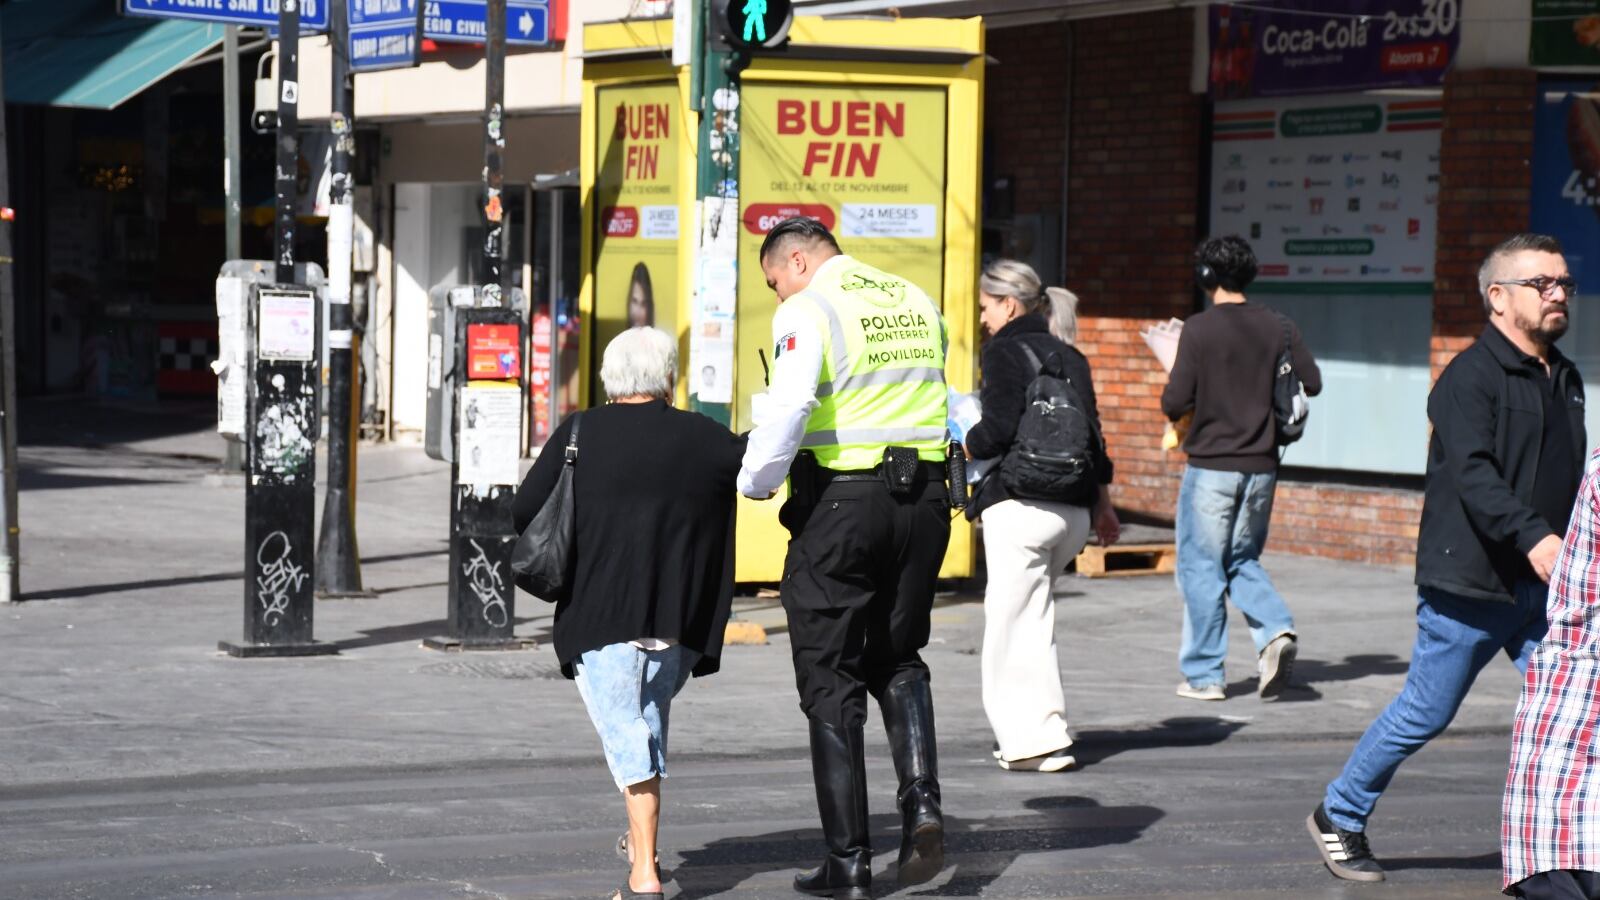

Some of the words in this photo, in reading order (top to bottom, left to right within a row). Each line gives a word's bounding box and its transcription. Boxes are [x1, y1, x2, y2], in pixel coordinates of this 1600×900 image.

[456, 19, 486, 36] CIVIL
[1262, 18, 1368, 55] Coca-Cola
[1388, 49, 1424, 66] Ahorra
[615, 103, 669, 141] BUEN
[776, 99, 905, 138] BUEN
[625, 144, 659, 180] FIN
[802, 142, 881, 177] FIN
[770, 182, 790, 191] DEL
[805, 183, 817, 191] AL
[834, 183, 846, 191] DE
[850, 183, 909, 192] NOVIEMBRE
[859, 208, 874, 219] 24
[878, 208, 919, 220] MESES
[860, 309, 927, 331] POLICÍA
[865, 330, 930, 344] MONTERREY
[868, 348, 935, 365] MOVILIDAD
